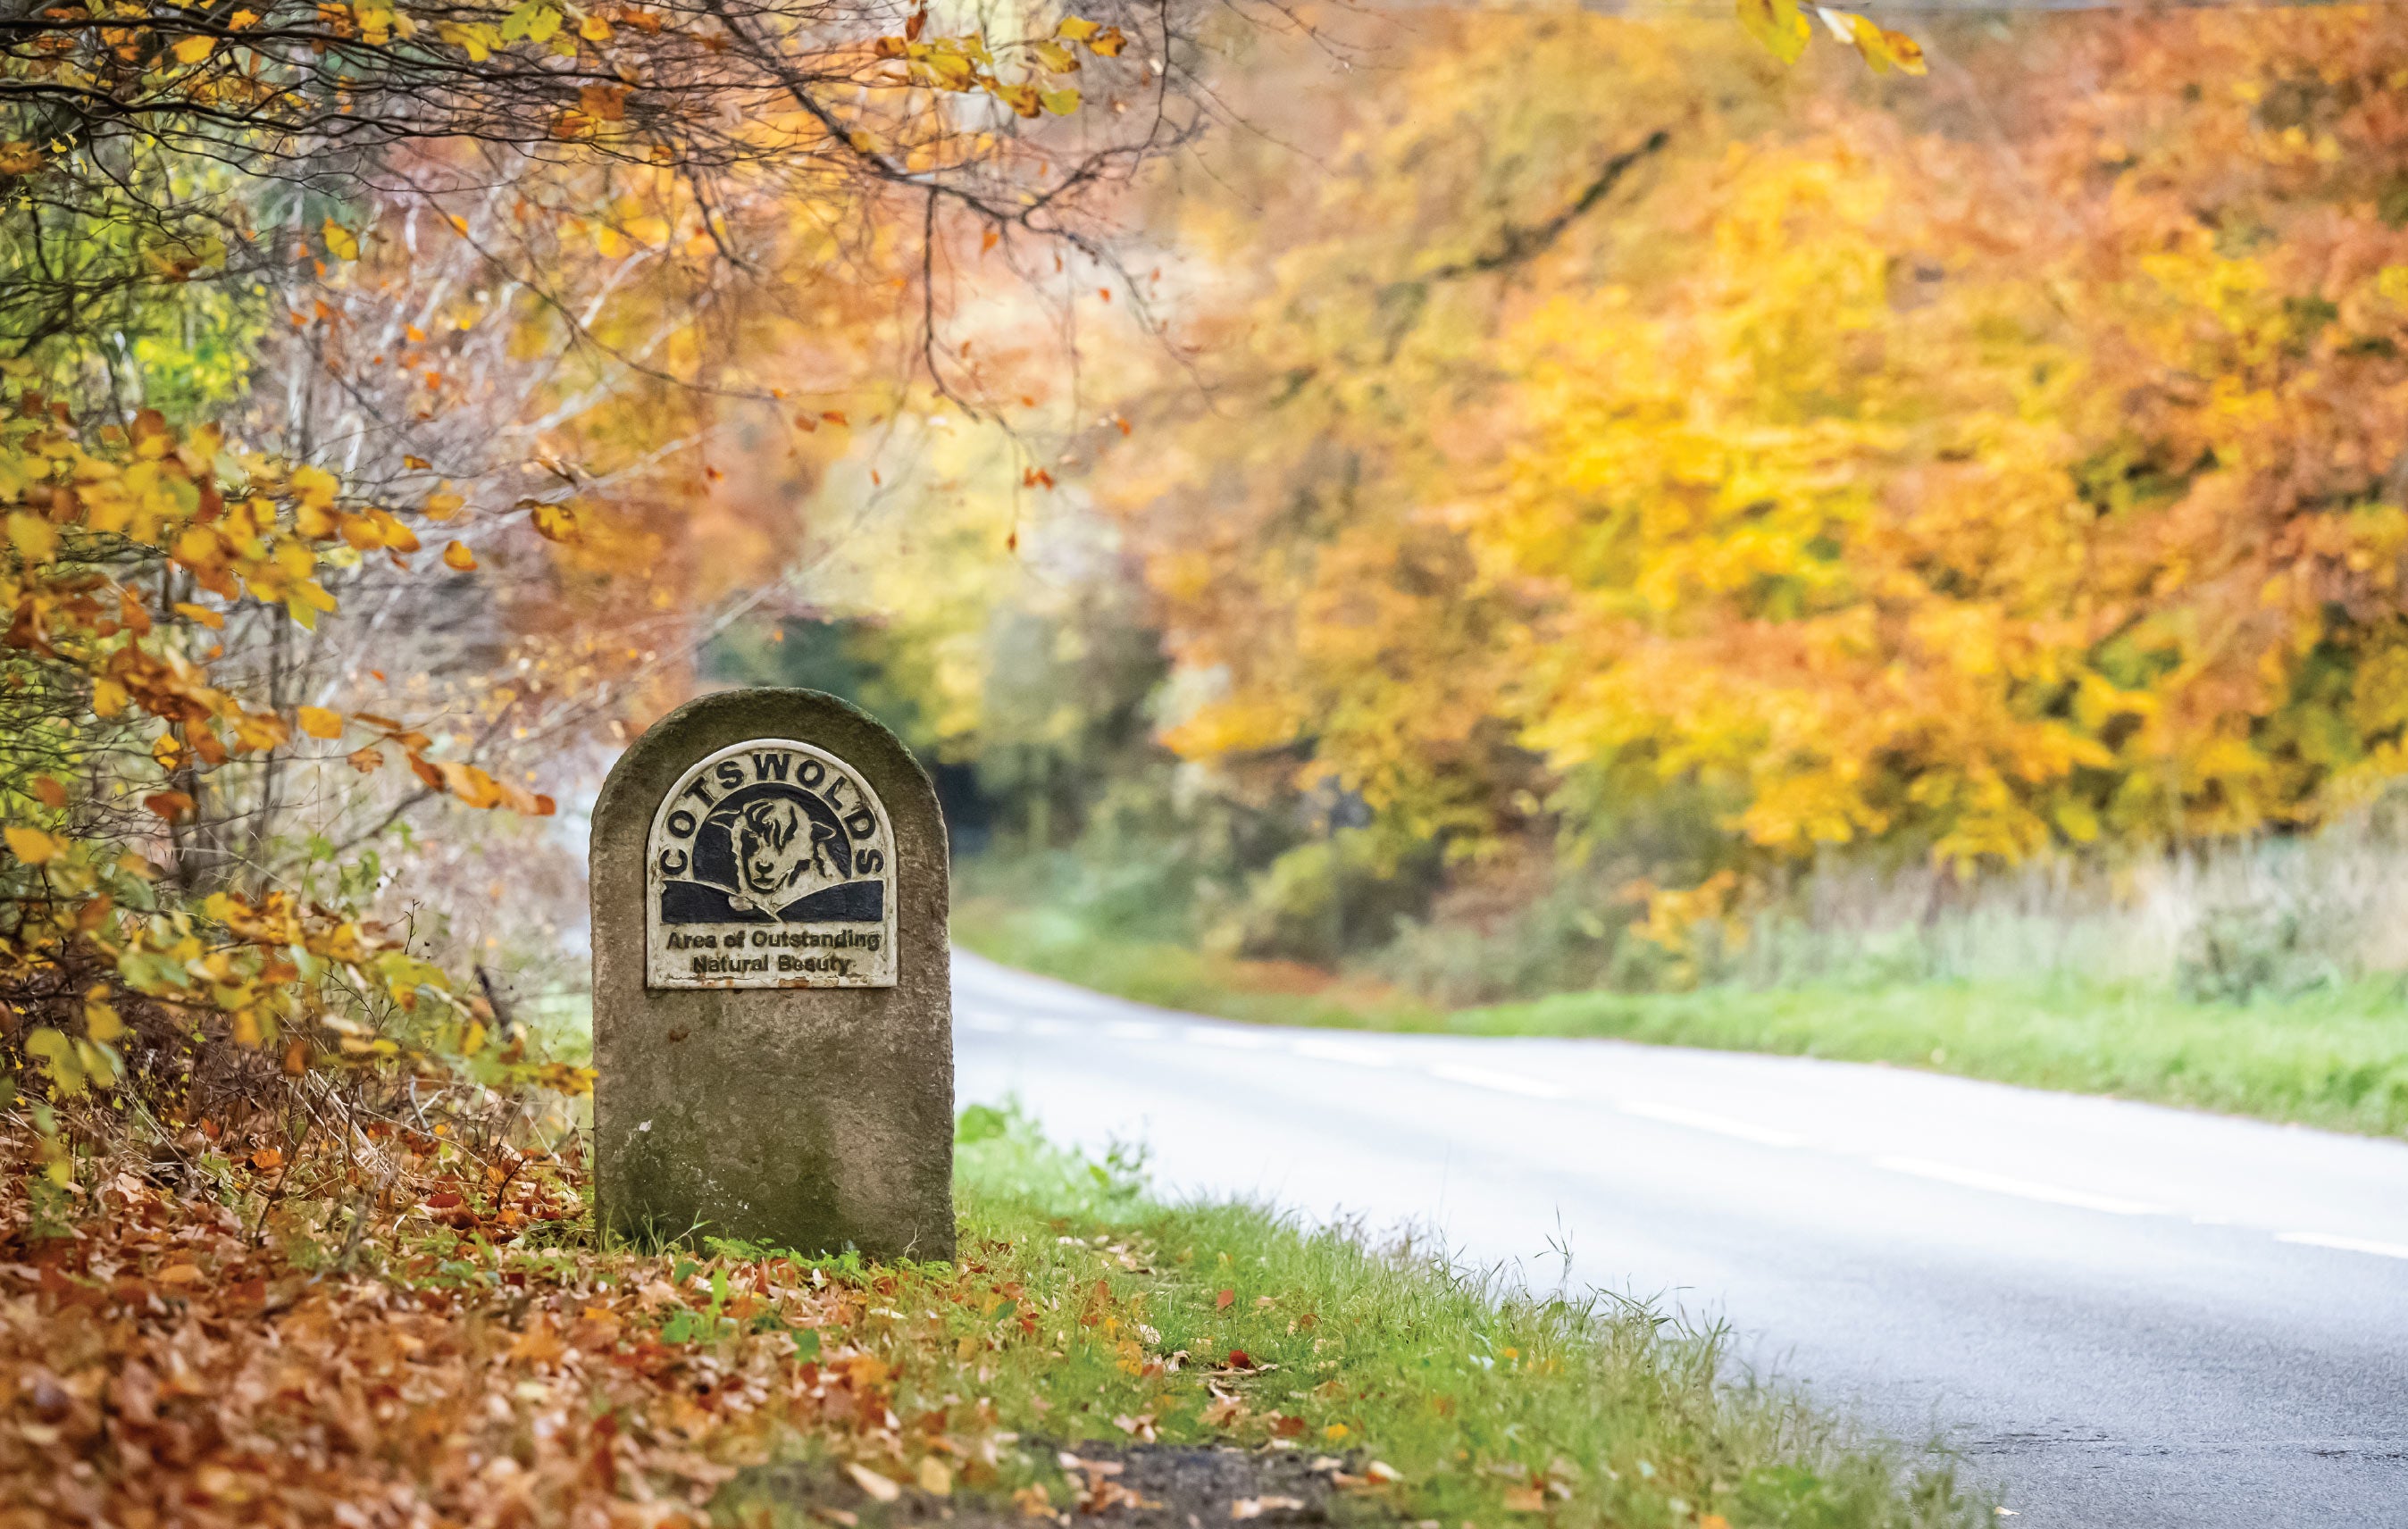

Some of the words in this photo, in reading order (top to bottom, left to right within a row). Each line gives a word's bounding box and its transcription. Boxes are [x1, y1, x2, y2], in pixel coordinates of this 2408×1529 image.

[660, 753, 884, 875] COTSWOLDS
[666, 932, 717, 950] Area
[723, 931, 746, 948] of
[751, 930, 881, 951] Outstanding
[692, 955, 769, 973] Natural
[778, 955, 850, 975] Beauty
